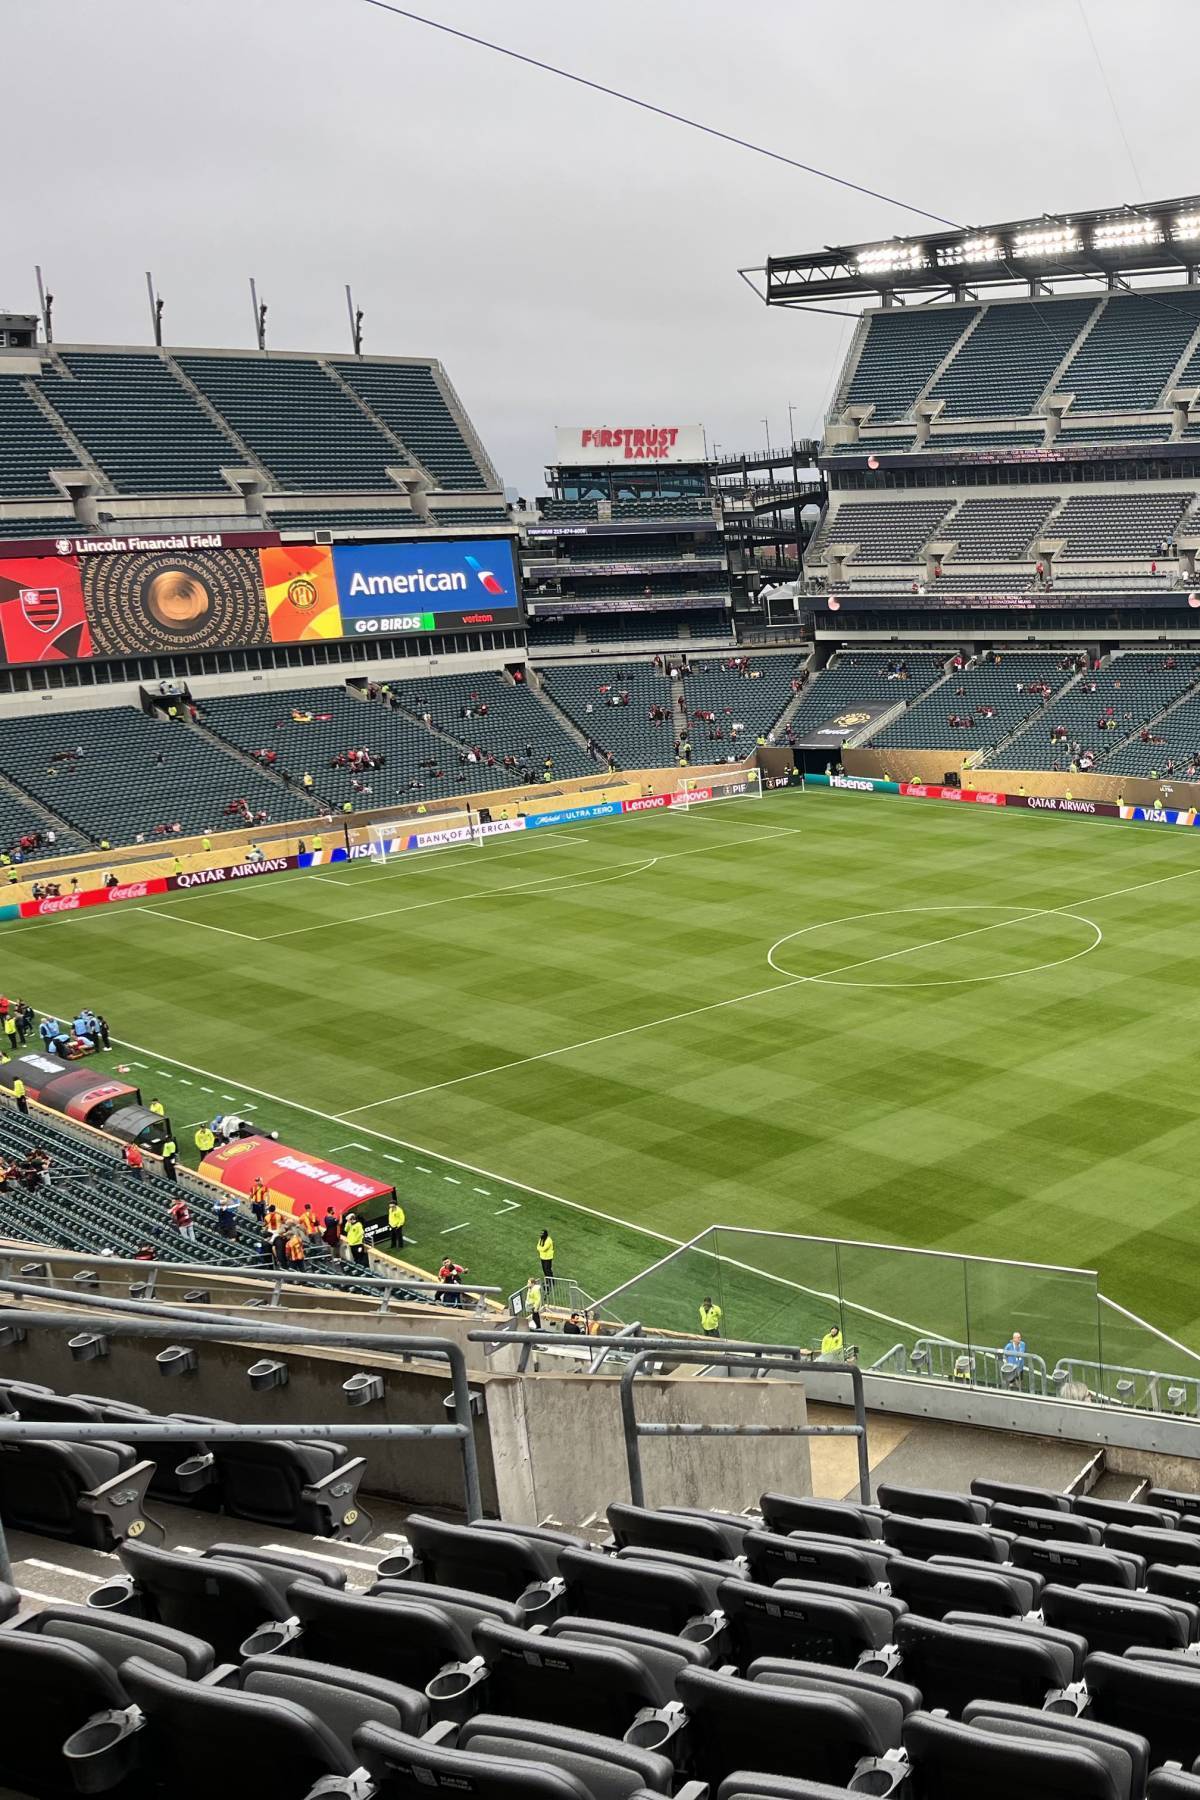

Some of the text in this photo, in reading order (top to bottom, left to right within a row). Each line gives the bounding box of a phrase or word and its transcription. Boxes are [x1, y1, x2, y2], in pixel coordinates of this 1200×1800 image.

[624, 447, 669, 459] BANK
[75, 535, 222, 553] Lincoln Financial Field
[349, 569, 467, 597] American
[355, 616, 420, 633] GO BIRDS
[462, 613, 493, 624] verizon
[732, 783, 746, 793] PIF
[776, 777, 790, 787] PIF
[829, 774, 873, 792] Hisense
[625, 797, 664, 811] Lenovo
[671, 790, 709, 804] Lenovo
[1026, 797, 1095, 814] QATAR AIRWAYS
[566, 810, 591, 819] ULTRA
[592, 805, 614, 815] ZERO
[1142, 808, 1168, 823] VISA
[419, 823, 511, 845] BANK OF AMERICA
[345, 842, 377, 859] VISA
[177, 858, 288, 888] QATAR AIRWAYS
[108, 881, 148, 901] Coca-Cola
[39, 893, 80, 914] Coca-Cola
